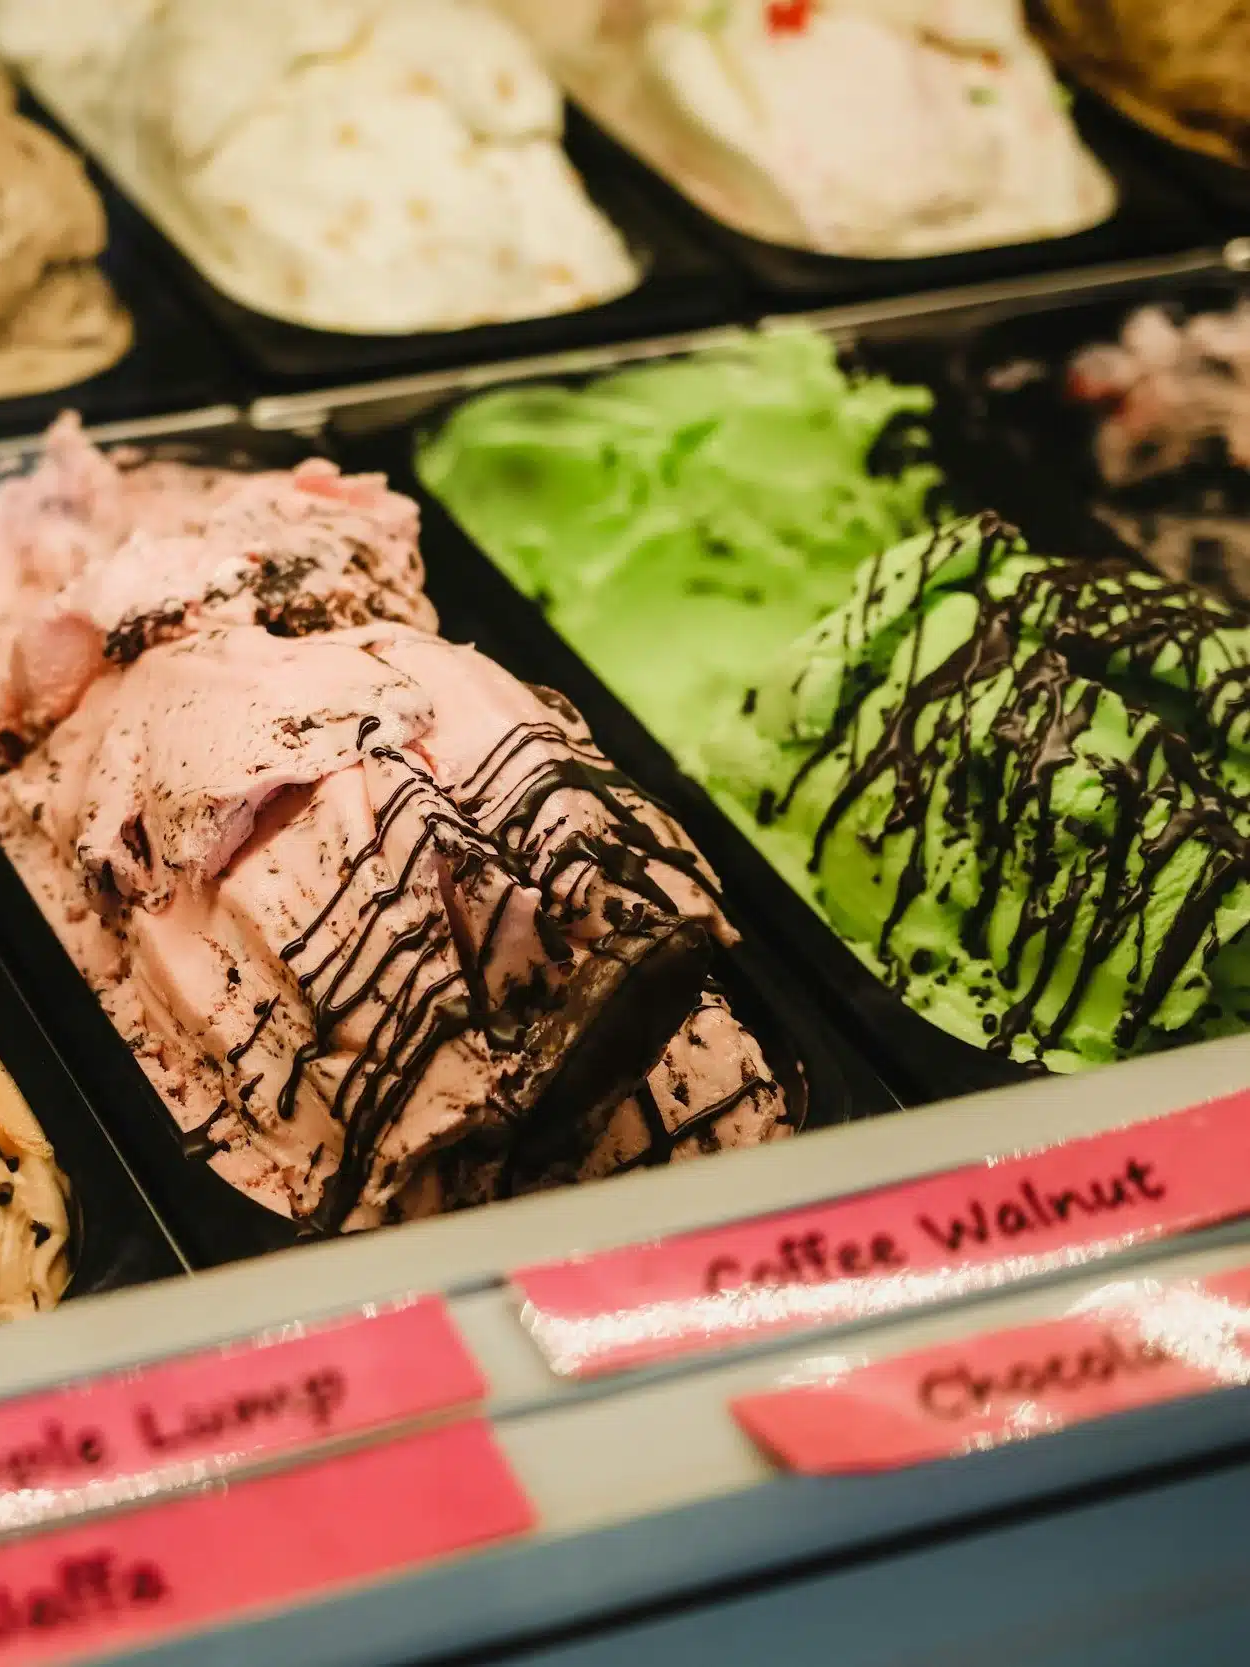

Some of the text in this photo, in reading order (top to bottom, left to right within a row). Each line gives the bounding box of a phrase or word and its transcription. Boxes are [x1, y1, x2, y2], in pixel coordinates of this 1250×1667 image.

[917, 1157, 1167, 1252] Walnut
[130, 1364, 348, 1452] Lump
[917, 1328, 1170, 1423] Chocola
